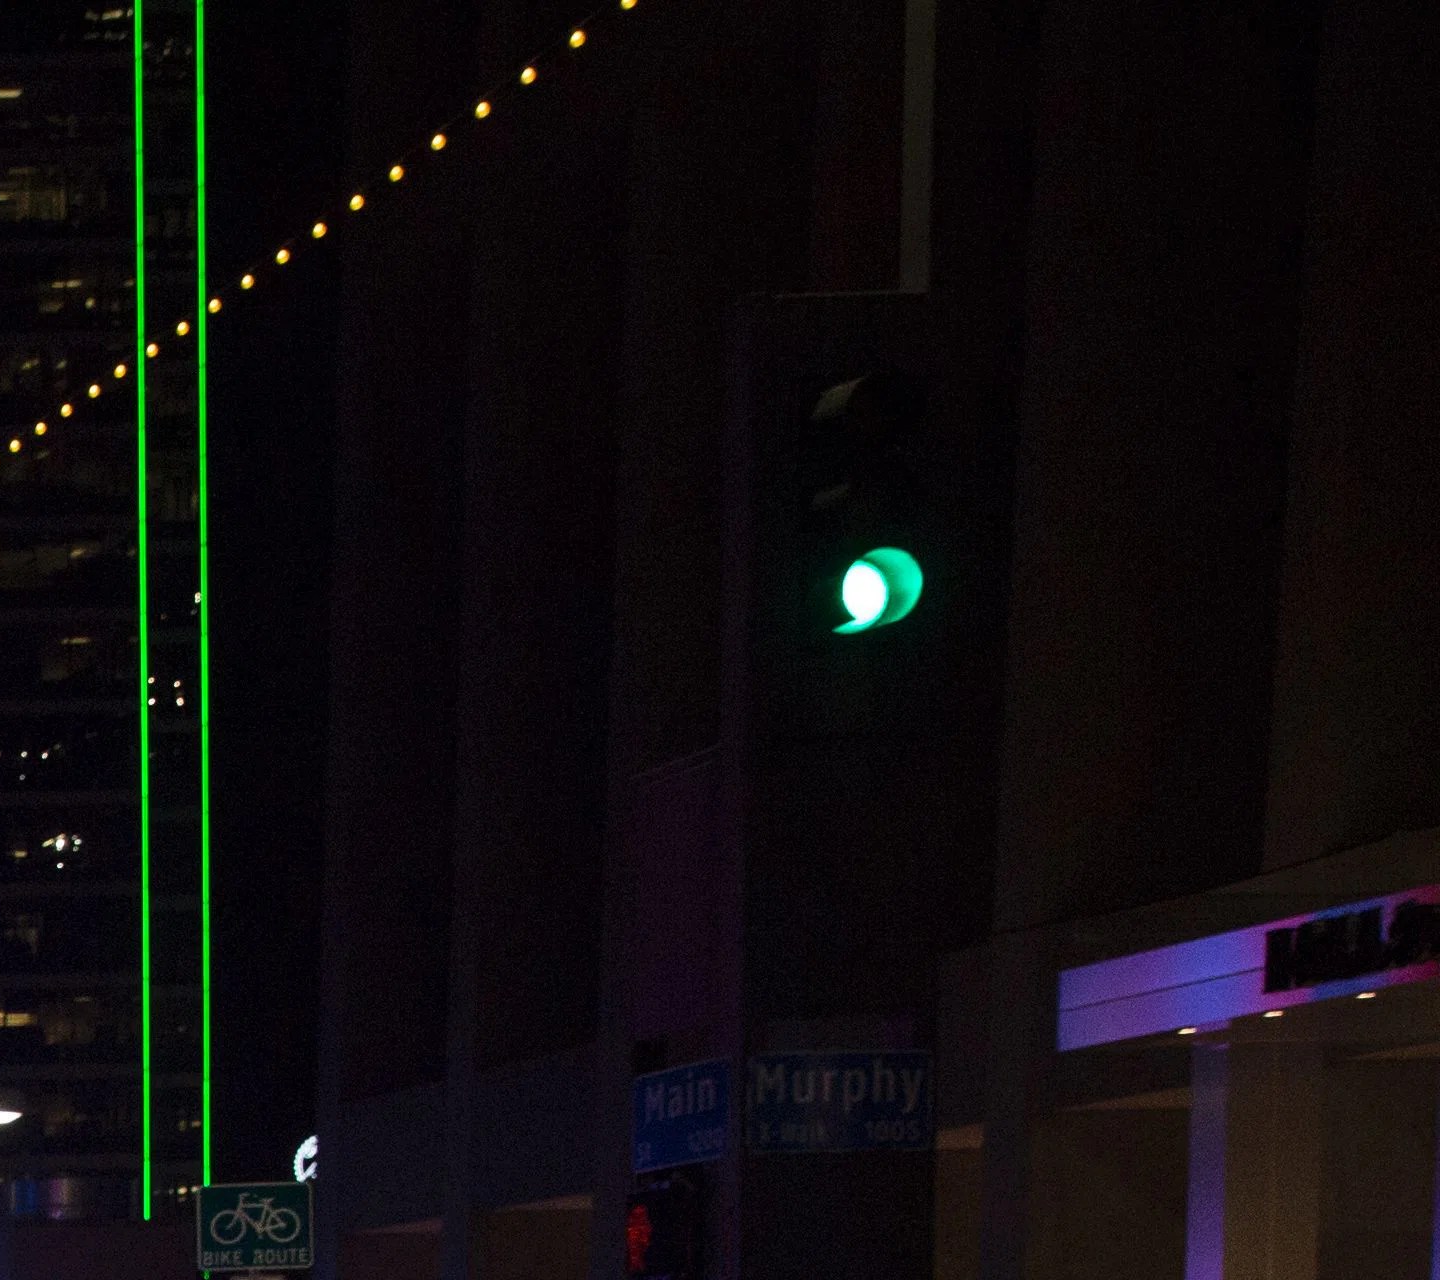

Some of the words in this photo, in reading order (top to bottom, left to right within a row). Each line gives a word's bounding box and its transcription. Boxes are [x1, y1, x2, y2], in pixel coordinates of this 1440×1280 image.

[644, 1072, 718, 1126] Main
[755, 1060, 925, 1116] Murphy
[203, 1250, 242, 1267] BIKE
[252, 1247, 310, 1265] ROUTE
